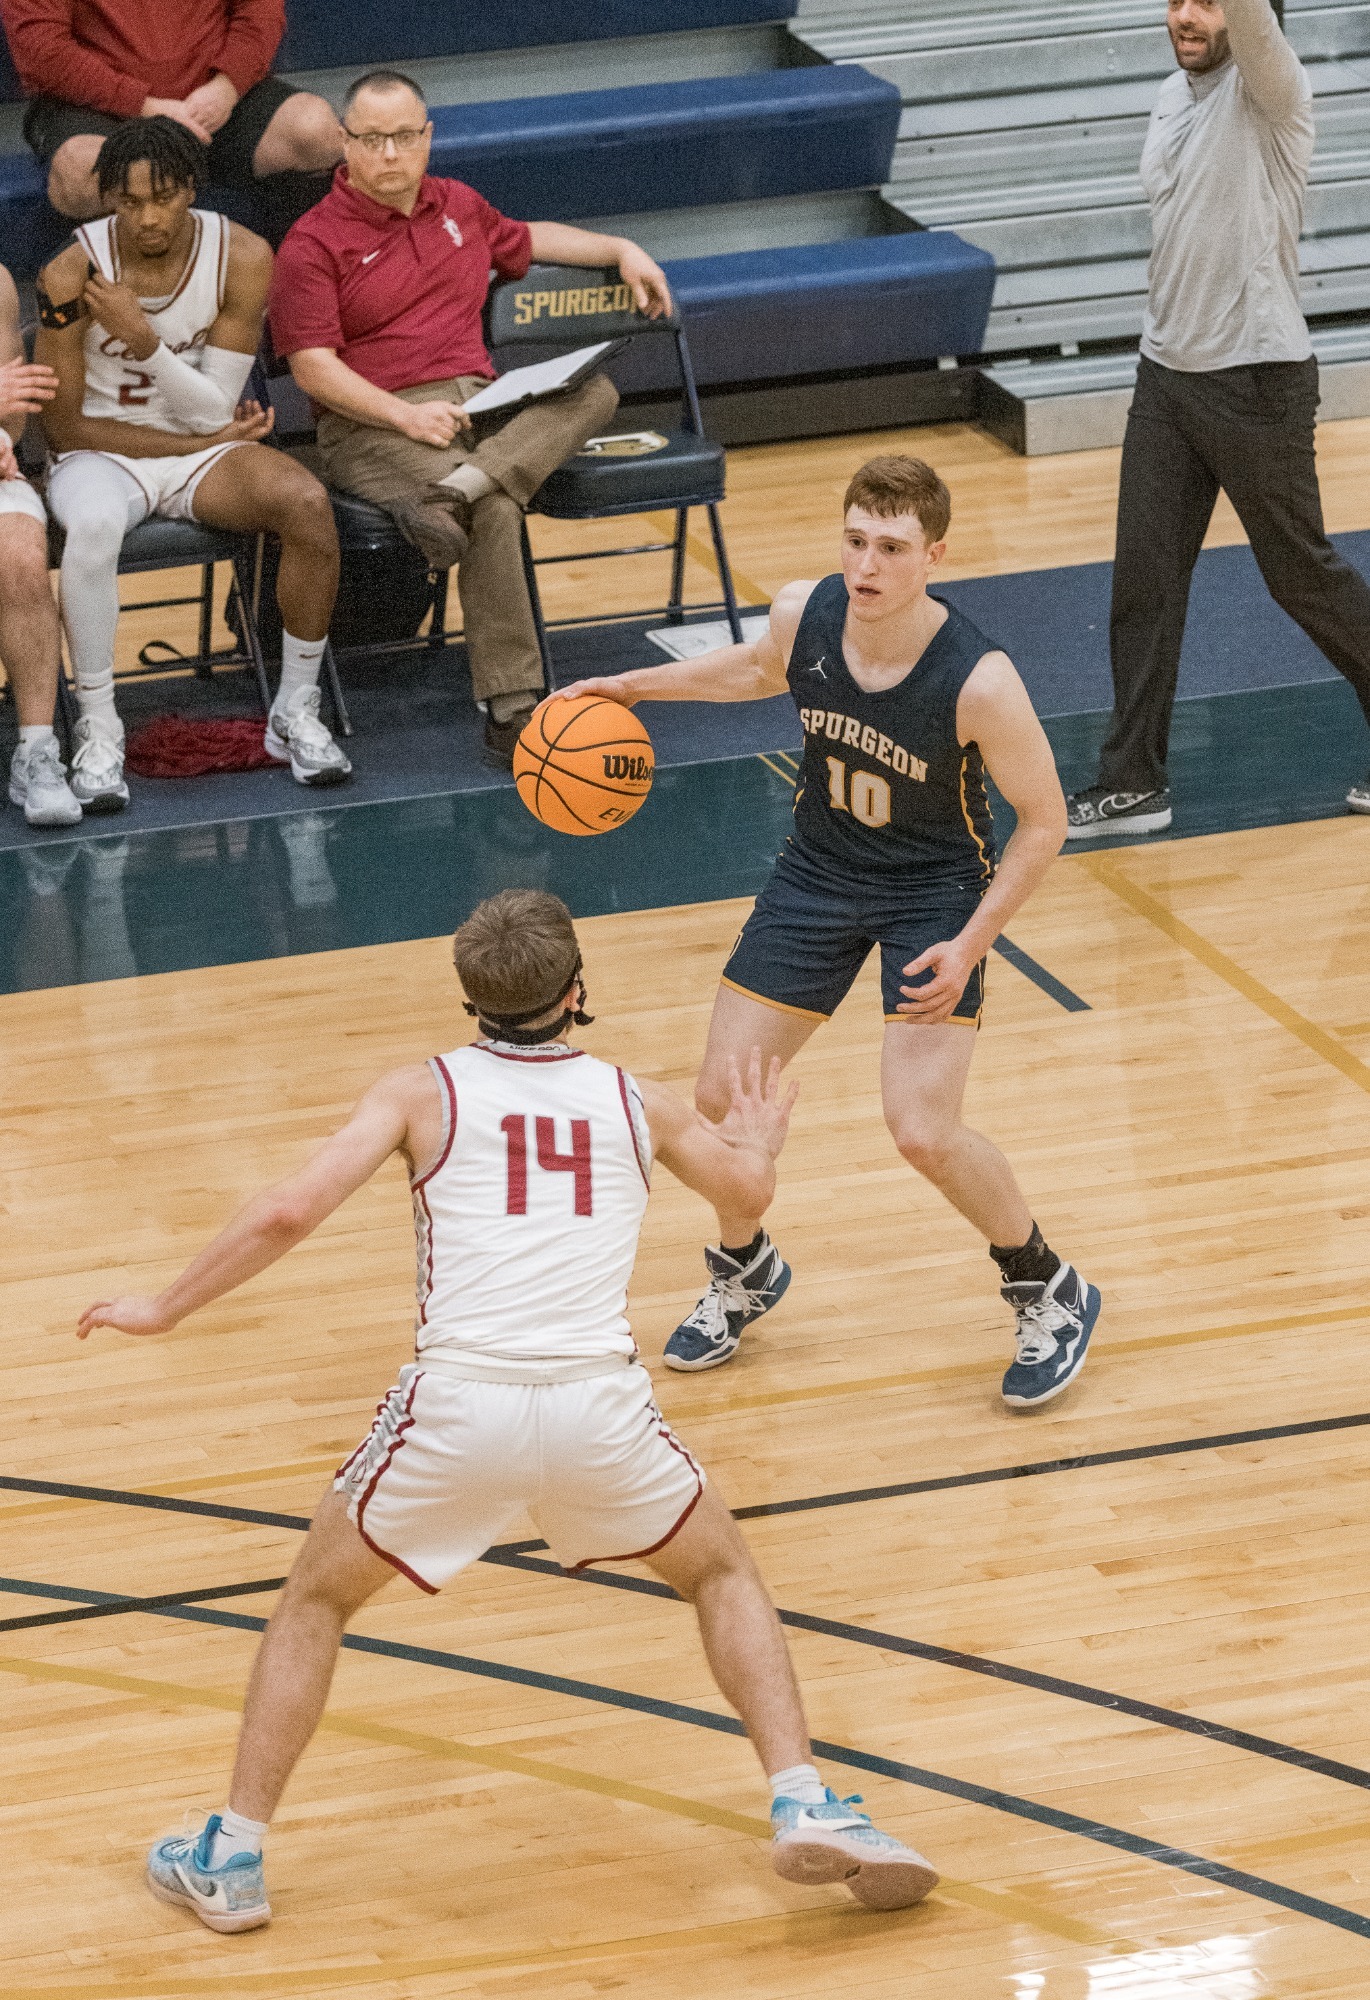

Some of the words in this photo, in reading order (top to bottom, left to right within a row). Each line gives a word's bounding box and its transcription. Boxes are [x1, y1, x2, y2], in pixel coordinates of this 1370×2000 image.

[800, 708, 928, 783] SPURGEON
[826, 756, 892, 828] 10
[500, 1114, 593, 1216] 14
